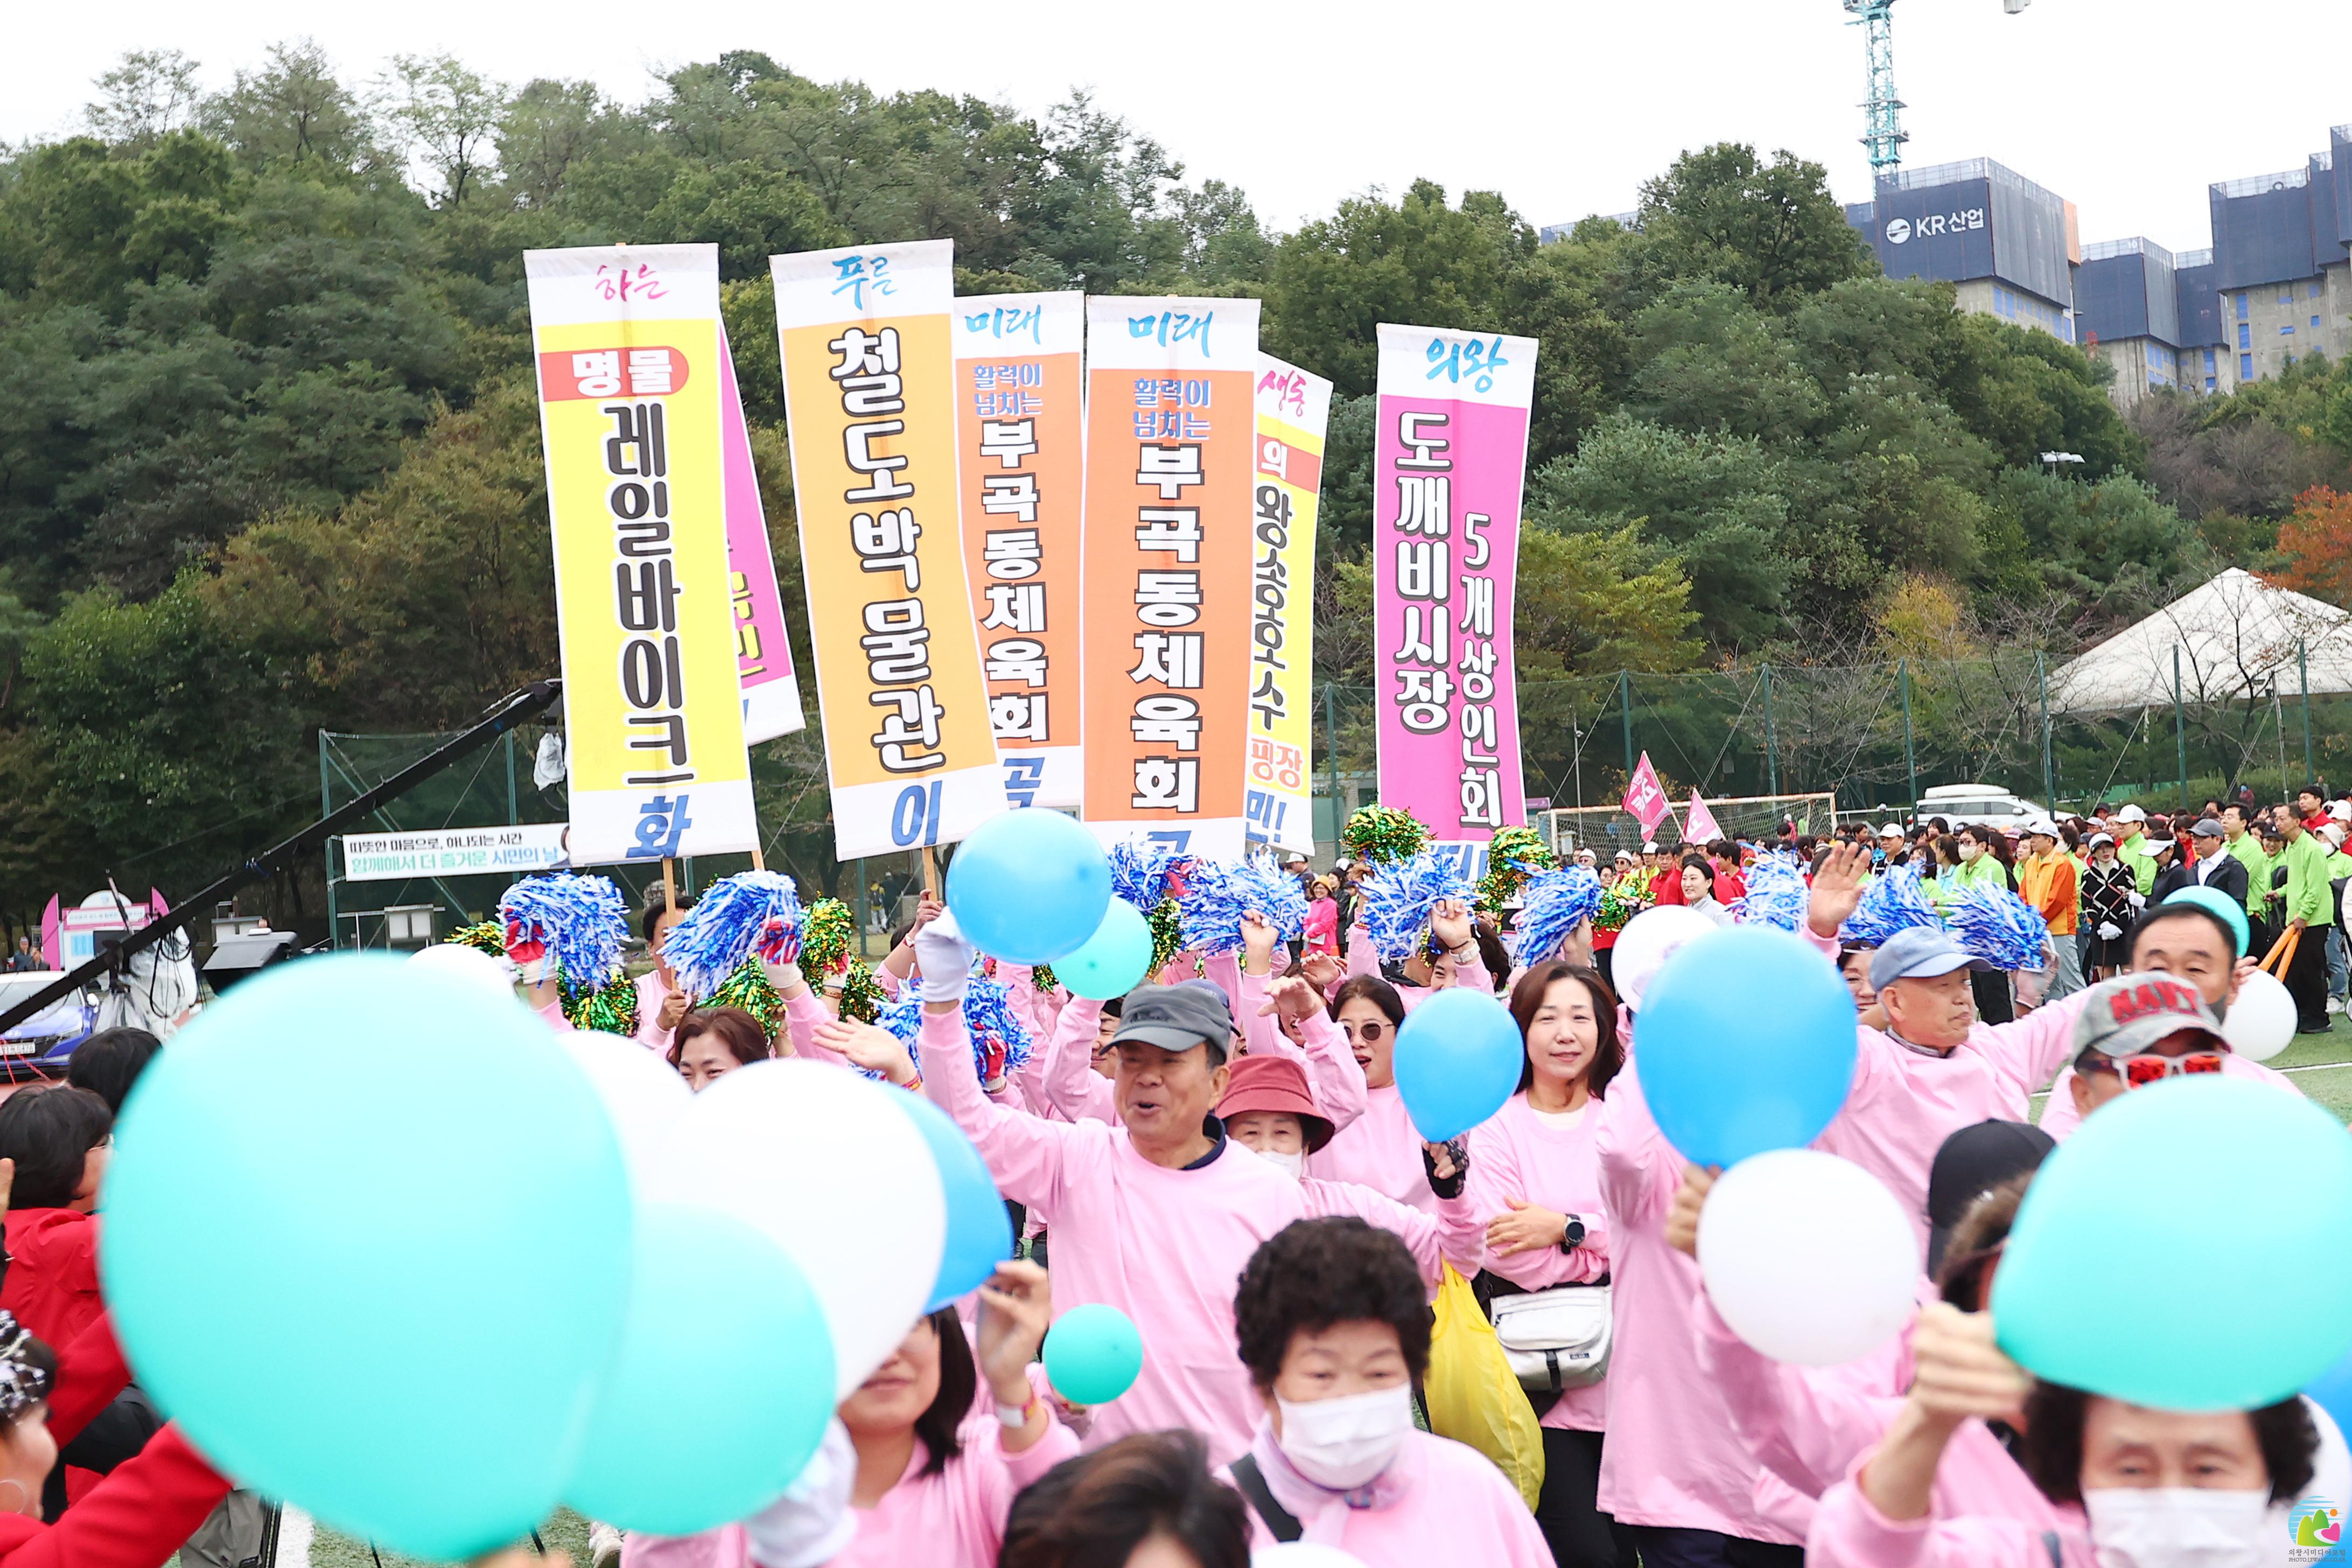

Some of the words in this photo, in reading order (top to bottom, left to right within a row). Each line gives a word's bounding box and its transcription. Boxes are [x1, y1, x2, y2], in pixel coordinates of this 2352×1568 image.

[594, 263, 669, 302] 하는
[964, 304, 1042, 345] 미래
[1128, 311, 1213, 358] 미래
[571, 348, 674, 397] 명물
[972, 363, 1042, 388] 활력이
[1426, 337, 1509, 393] 의왕
[974, 393, 1042, 417] 넘치는
[1133, 379, 1212, 408] 활력이
[1133, 411, 1212, 440] 넘치는
[828, 326, 946, 773] 철도박물관
[1394, 411, 1456, 735] 도깨비시장
[603, 402, 695, 785] 레일바이크
[979, 417, 1050, 742] 부곡동체육회
[1126, 443, 1205, 813] 부곡동체육회
[626, 794, 692, 858] 화
[891, 780, 942, 846] 이
[350, 841, 387, 853] 따뜻한
[390, 838, 443, 851] 마음으로,
[446, 835, 494, 848] 하나되는
[499, 832, 522, 845] 시간
[352, 855, 416, 873] 함께해서
[421, 853, 436, 869] 더
[440, 851, 487, 868] 즐거운
[492, 848, 539, 865] 시민의
[543, 847, 558, 863] 날
[2109, 981, 2199, 1020] NAVY
